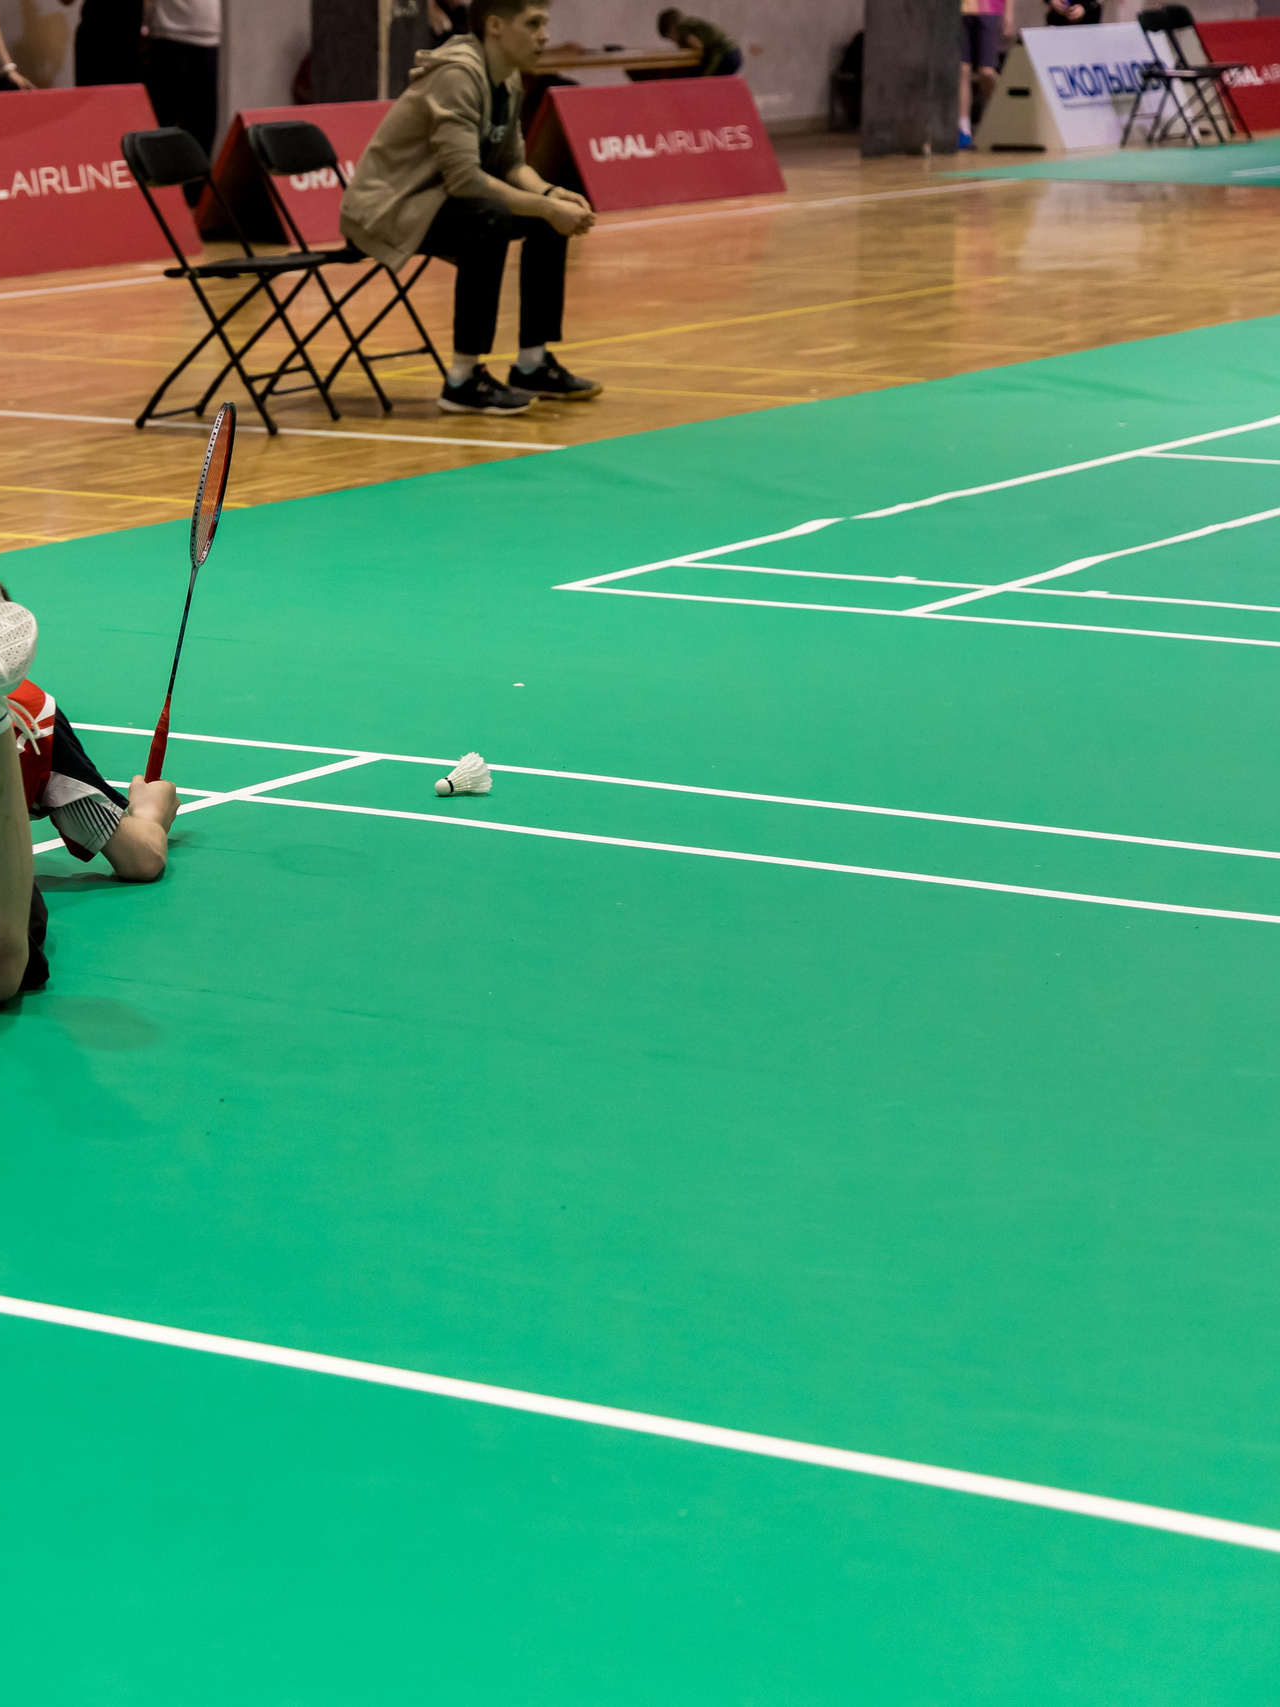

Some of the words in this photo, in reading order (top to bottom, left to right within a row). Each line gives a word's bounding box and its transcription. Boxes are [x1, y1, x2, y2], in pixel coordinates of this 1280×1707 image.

[589, 133, 656, 162] URAL
[655, 125, 753, 156] AIRLINES
[10, 159, 136, 199] AIRLINE
